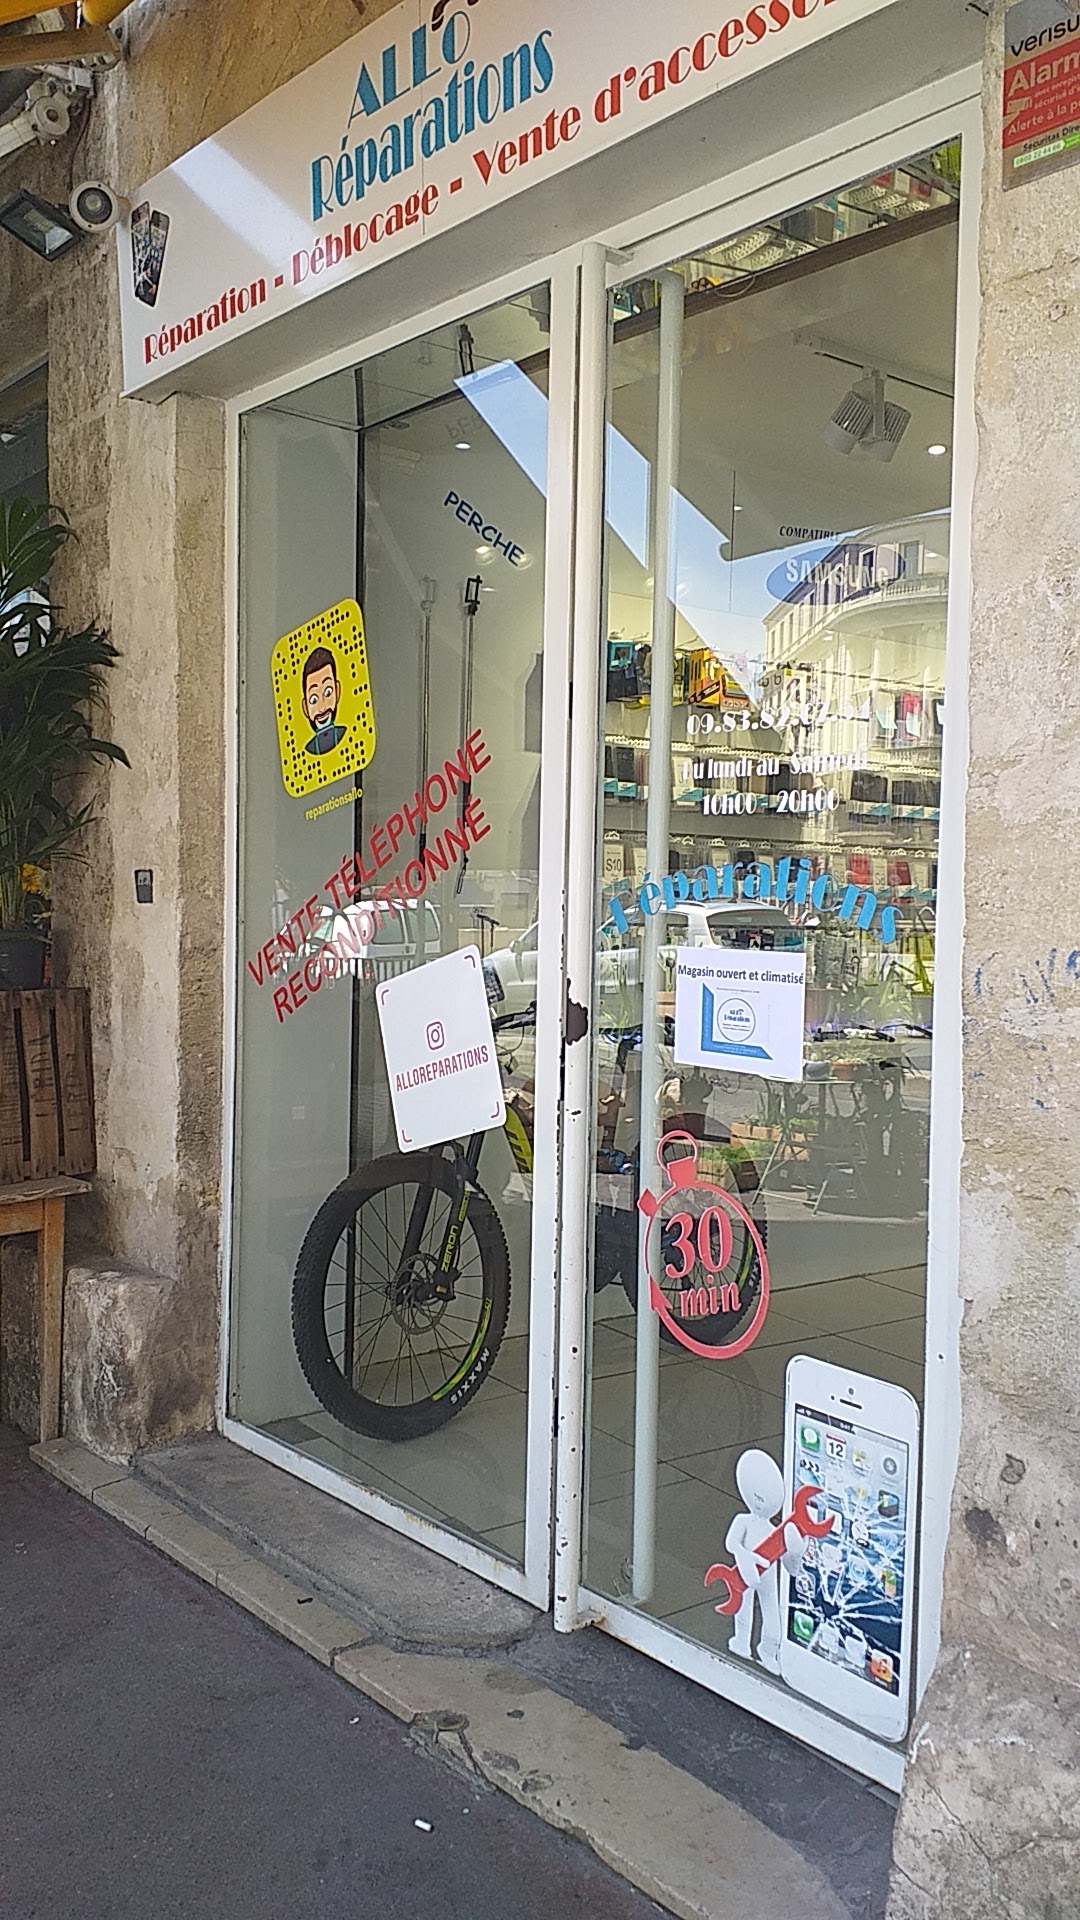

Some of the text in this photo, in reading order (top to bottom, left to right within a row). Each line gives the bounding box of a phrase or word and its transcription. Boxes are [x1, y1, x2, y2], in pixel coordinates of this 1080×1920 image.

[311, 30, 554, 222] Réparations
[1008, 114, 1044, 136] Alerte
[1057, 104, 1067, 116] la
[1023, 132, 1060, 152] Securitas
[144, 278, 266, 365] Réparation
[292, 184, 438, 286] Déblocage
[472, 106, 581, 186] Vente
[443, 490, 525, 567] PERCHE
[786, 558, 889, 590] SAMSUNG
[756, 756, 780, 776] au
[305, 786, 363, 821] reparationsallo
[247, 729, 492, 986] VENTE TÉLÉPHONE
[272, 797, 491, 1024] RECONDITIONNÉ
[678, 964, 804, 985] Magasin ouvert et climatisé
[395, 1044, 490, 1092] ALLOREPARATIONS
[665, 1206, 733, 1279] 30
[679, 1274, 742, 1317] min
[450, 1348, 490, 1404] MAXXIS
[829, 1442, 844, 1458] 12
